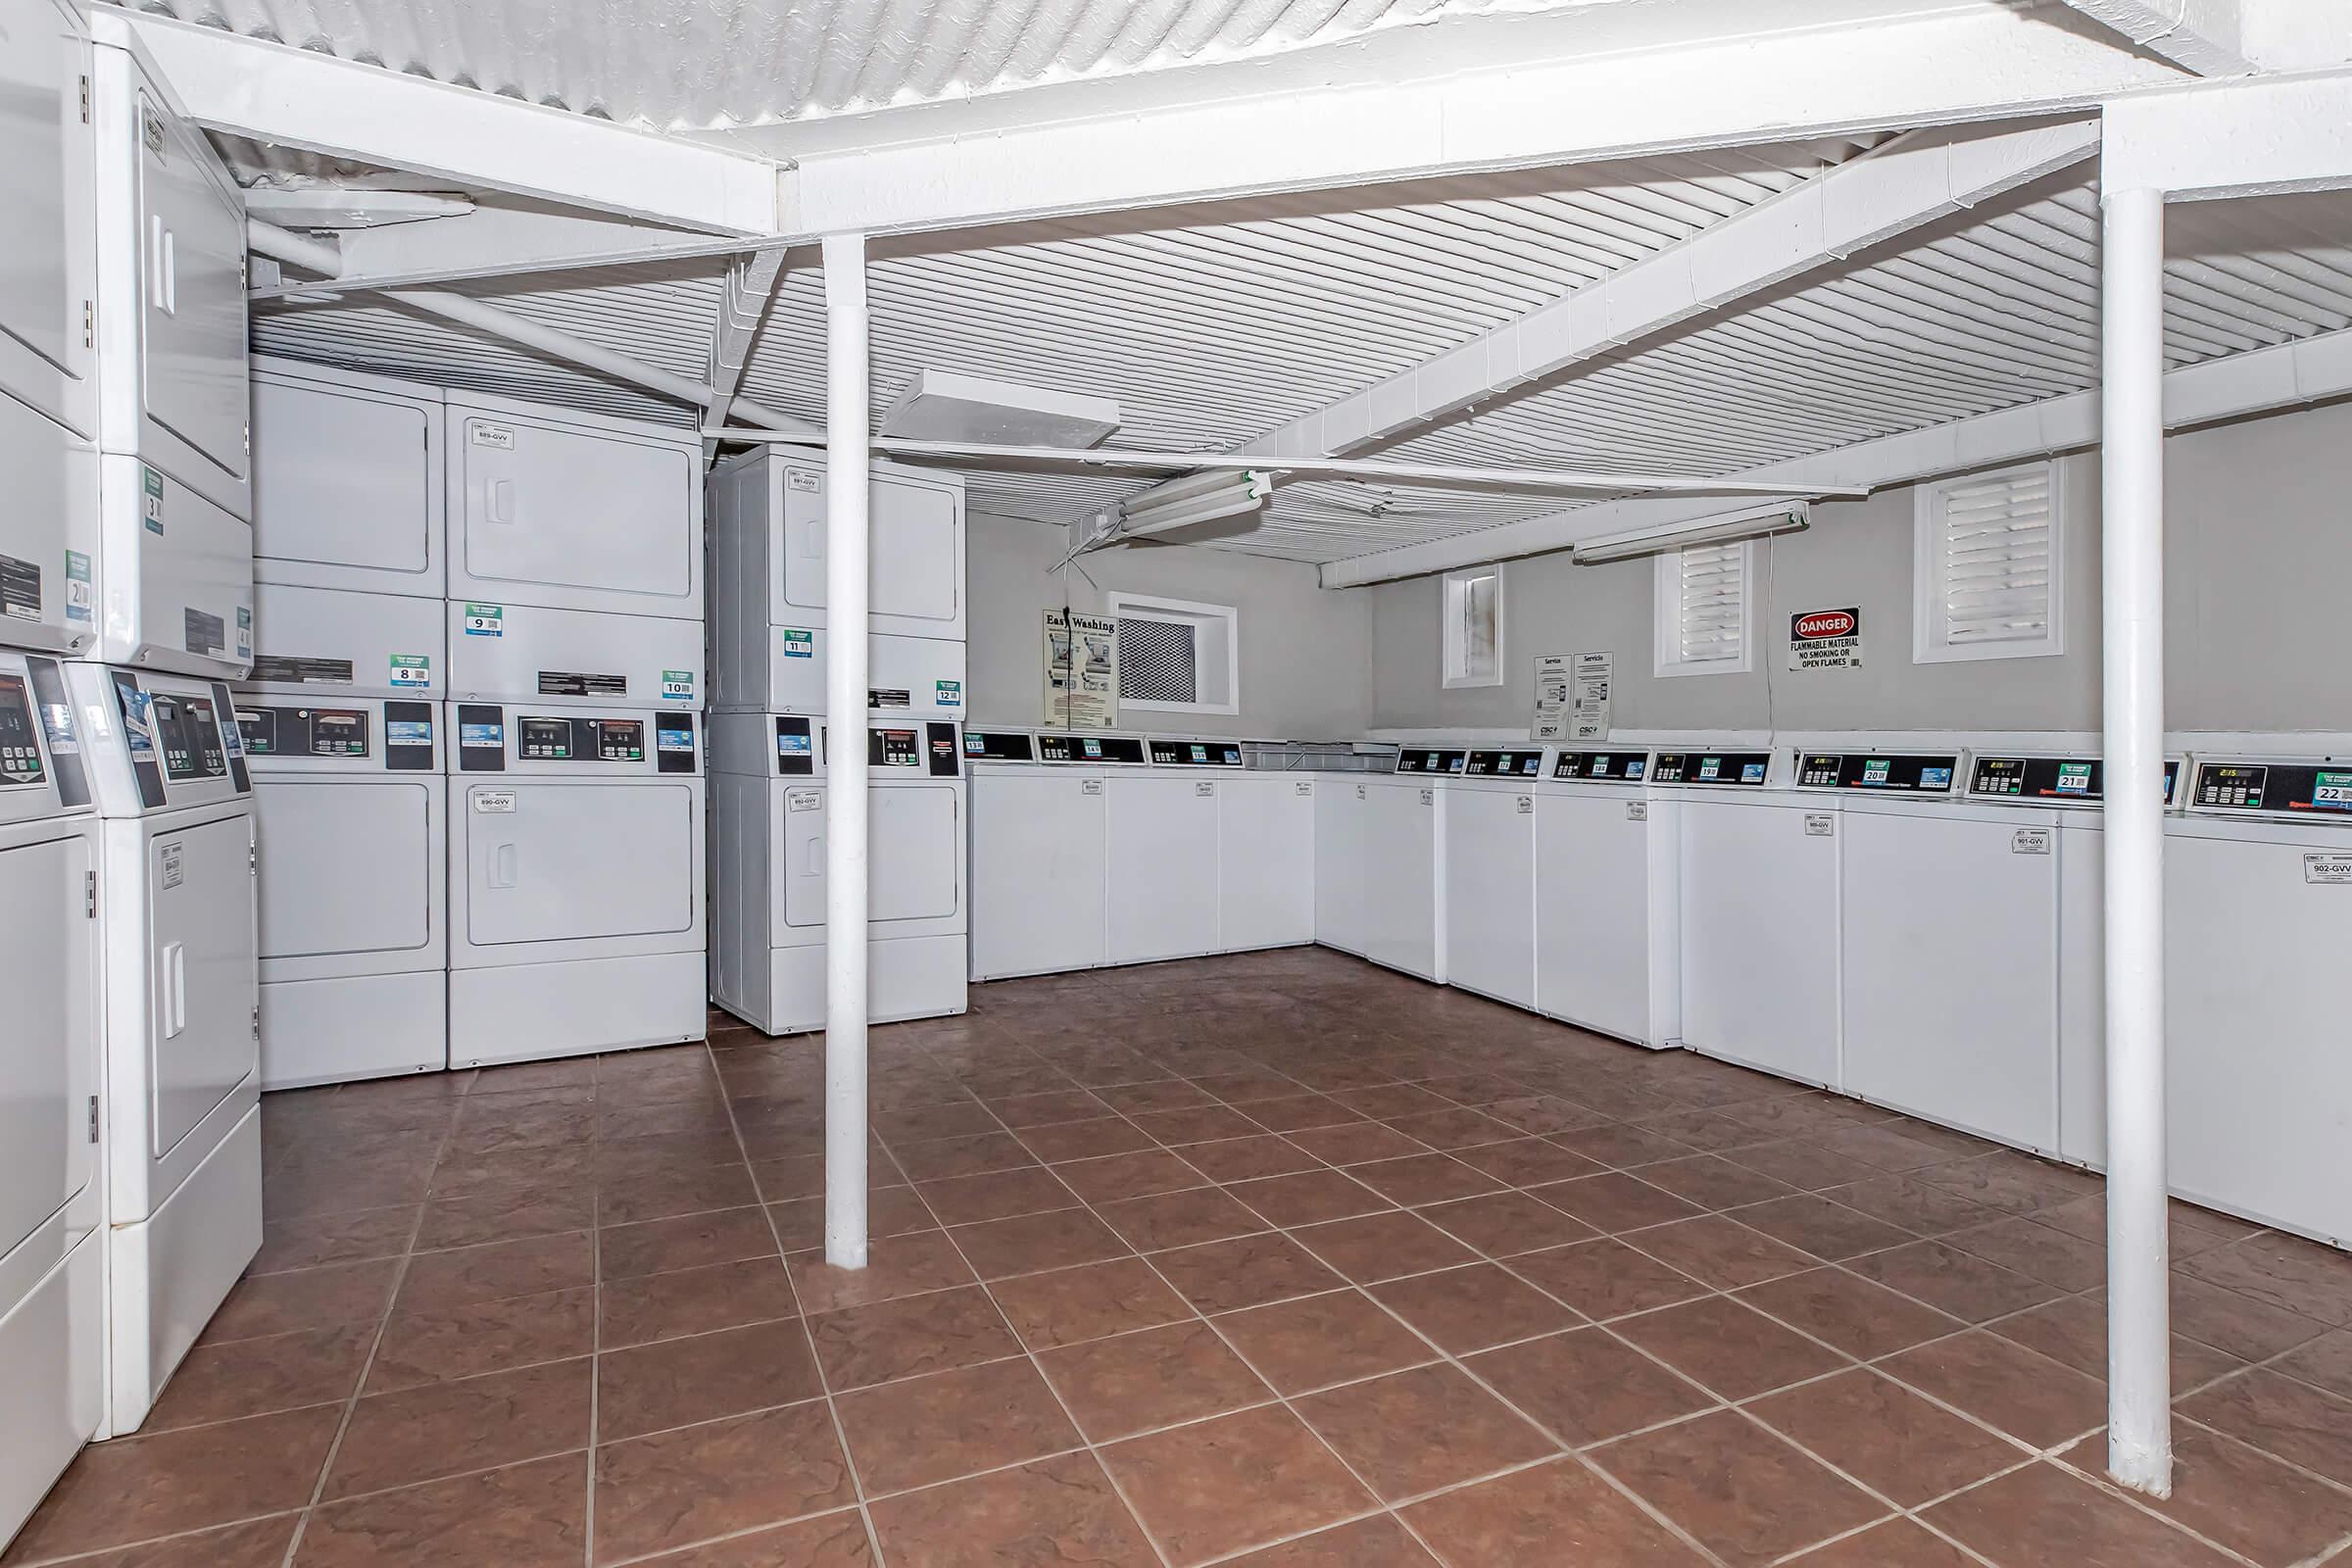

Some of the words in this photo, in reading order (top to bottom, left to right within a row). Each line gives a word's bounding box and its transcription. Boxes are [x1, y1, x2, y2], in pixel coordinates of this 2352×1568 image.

[149, 497, 155, 517] 3
[72, 583, 79, 603] 2
[474, 618, 484, 628] 9
[1047, 614, 1068, 629] Easy
[1072, 616, 1115, 634] Washing
[1799, 617, 1848, 633] DANGER
[790, 642, 799, 651] 11
[1790, 640, 1828, 652] FLAMMABLE
[1828, 636, 1859, 649] MATERIAL
[1584, 654, 1603, 662] Servicio
[1799, 651, 1808, 660] NO
[1809, 649, 1839, 659] SMOKING
[1801, 660, 1820, 668] OPEN
[1820, 658, 1846, 667] FLAMES
[400, 668, 410, 679] 8
[667, 683, 681, 693] 10
[940, 691, 950, 700] 12
[1866, 771, 1879, 780] 20
[2061, 776, 2076, 786] 21
[2320, 788, 2339, 799] 22
